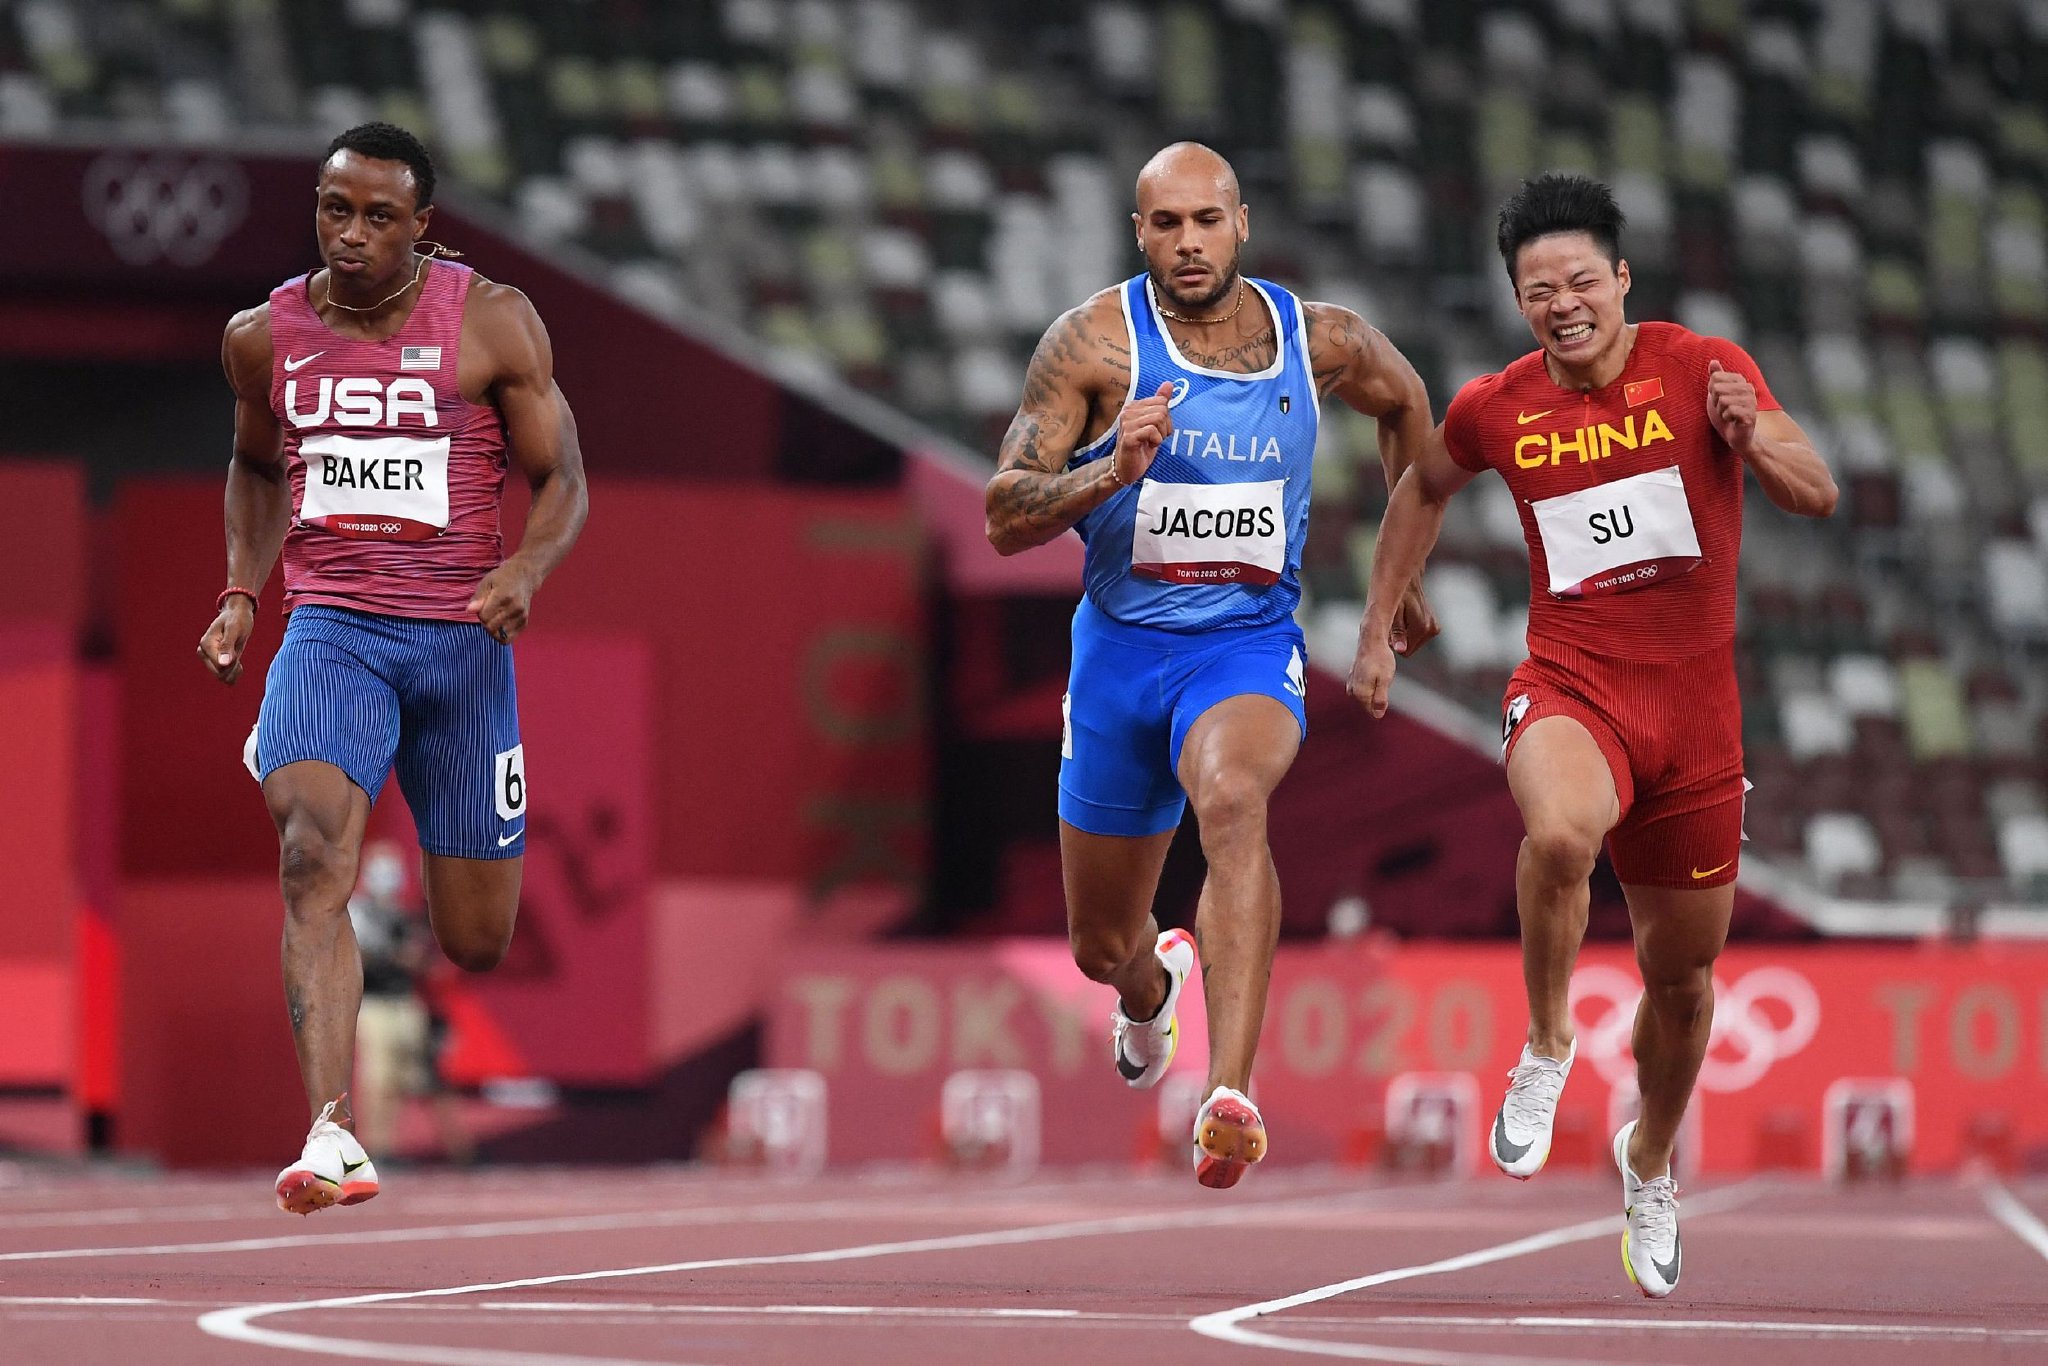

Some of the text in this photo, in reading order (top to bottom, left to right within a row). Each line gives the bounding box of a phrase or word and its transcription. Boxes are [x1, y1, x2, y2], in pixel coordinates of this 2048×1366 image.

[285, 377, 439, 428] USA
[1170, 428, 1282, 463] ITALIA
[1514, 409, 1675, 469] CHINA
[321, 455, 425, 491] BAKER
[338, 521, 379, 532] TOKYO 2020
[1149, 506, 1275, 539] JACOBS
[1588, 504, 1635, 545] SU
[1176, 569, 1218, 578] TOKYO 2020
[1594, 572, 1636, 589] TOKYO 2020
[504, 756, 523, 810] 6
[1878, 980, 2048, 1079] TO
